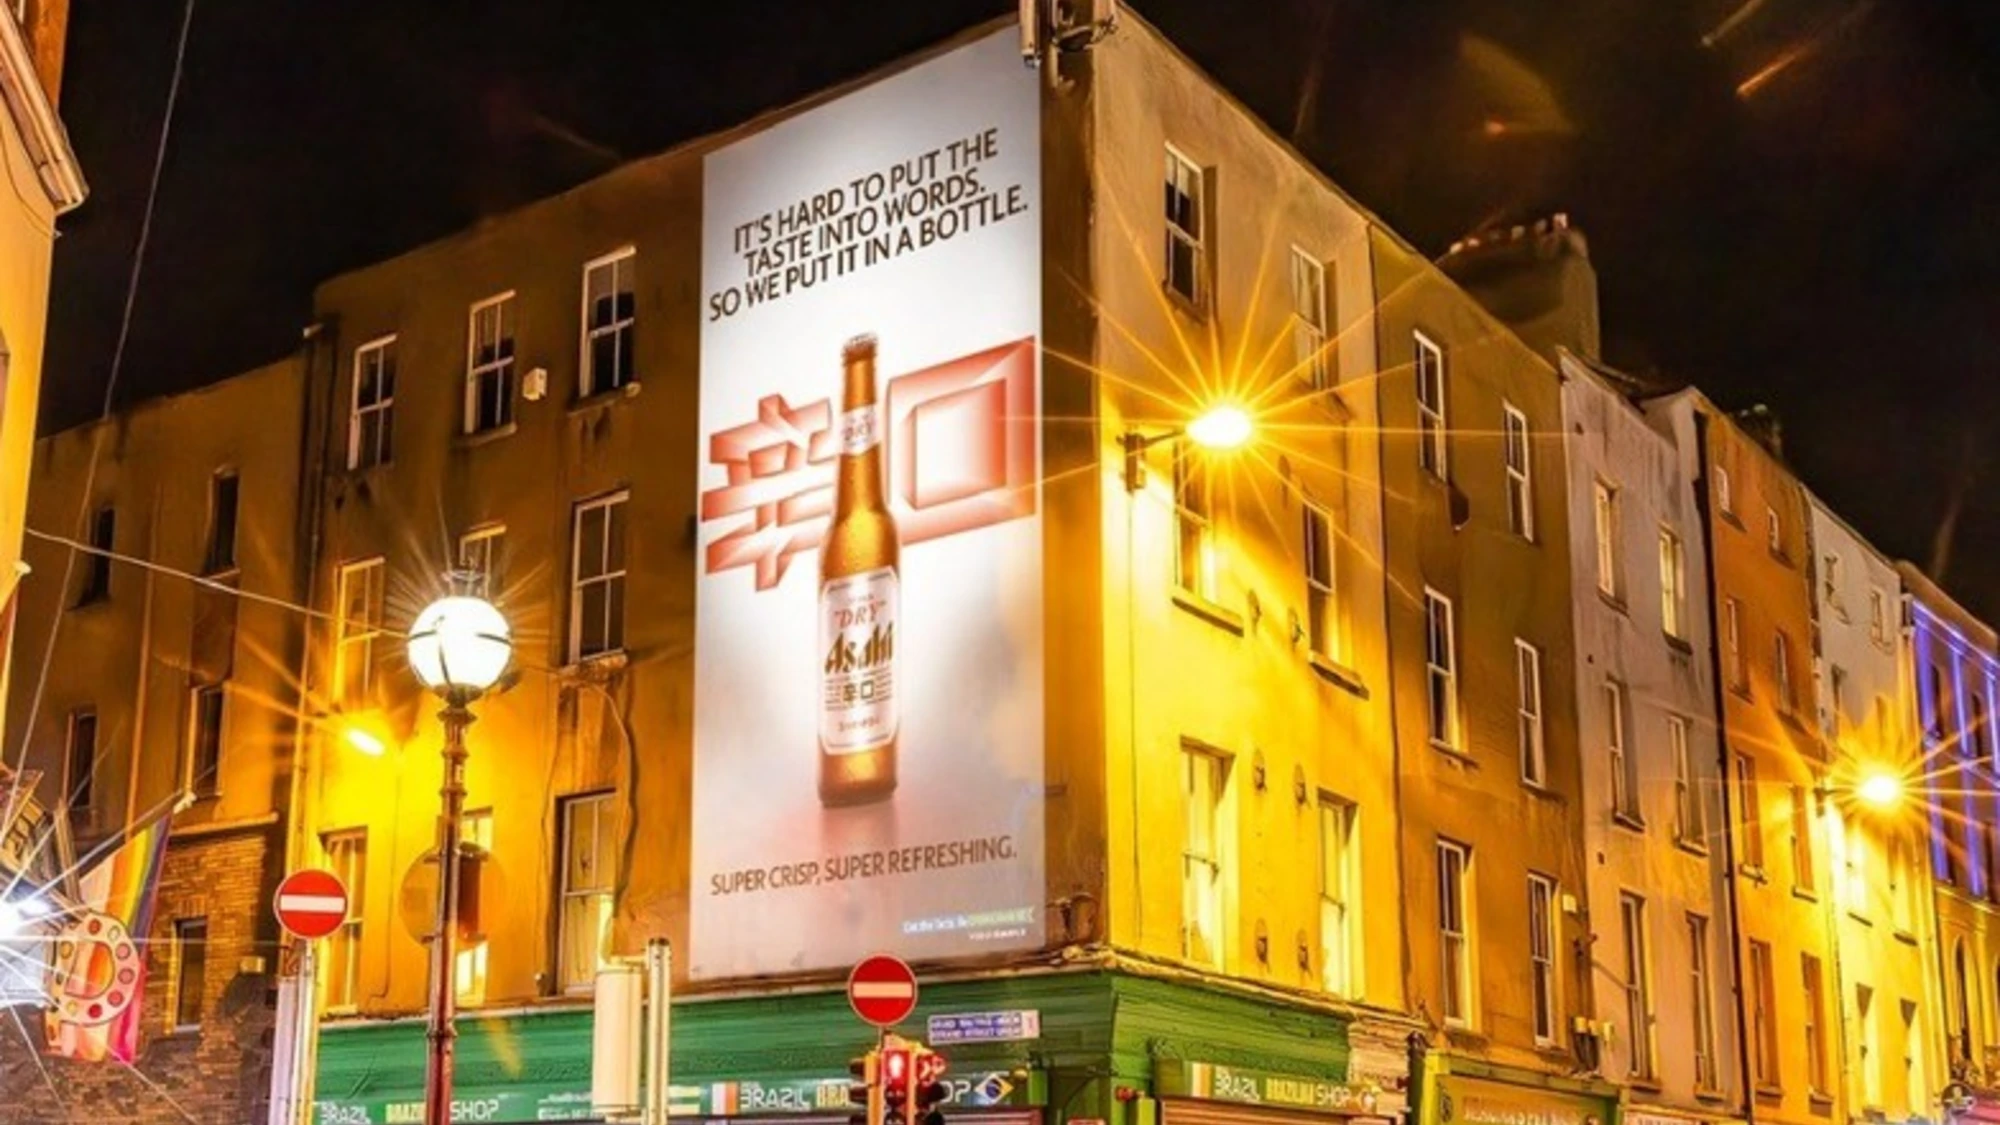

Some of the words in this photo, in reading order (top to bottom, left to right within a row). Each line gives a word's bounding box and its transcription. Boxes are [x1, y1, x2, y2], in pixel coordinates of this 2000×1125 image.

[734, 213, 772, 254] IT'S
[777, 188, 845, 237] HARD
[850, 172, 885, 207] TO
[890, 149, 941, 194] PUT
[945, 127, 998, 171] THE
[744, 230, 813, 277] TASTE
[818, 206, 878, 252] INTO
[883, 167, 986, 228] WORDS.
[709, 286, 742, 322] SO
[745, 271, 781, 308] WE
[785, 253, 833, 295] PUT
[837, 243, 859, 276] IT
[864, 231, 891, 267] IN
[895, 225, 915, 257] A
[919, 184, 1029, 248] BOTTLE.
[825, 620, 894, 676] Asahi
[711, 868, 766, 896] SUPER
[769, 861, 821, 888] CRISP,
[824, 855, 886, 883] SUPER
[888, 835, 1018, 874] REFRESHING.
[450, 1099, 499, 1121] SHOP
[739, 1080, 811, 1110] BRAZIL
[1214, 1065, 1261, 1101] BRAZIL
[1316, 1084, 1351, 1107] SHOP
